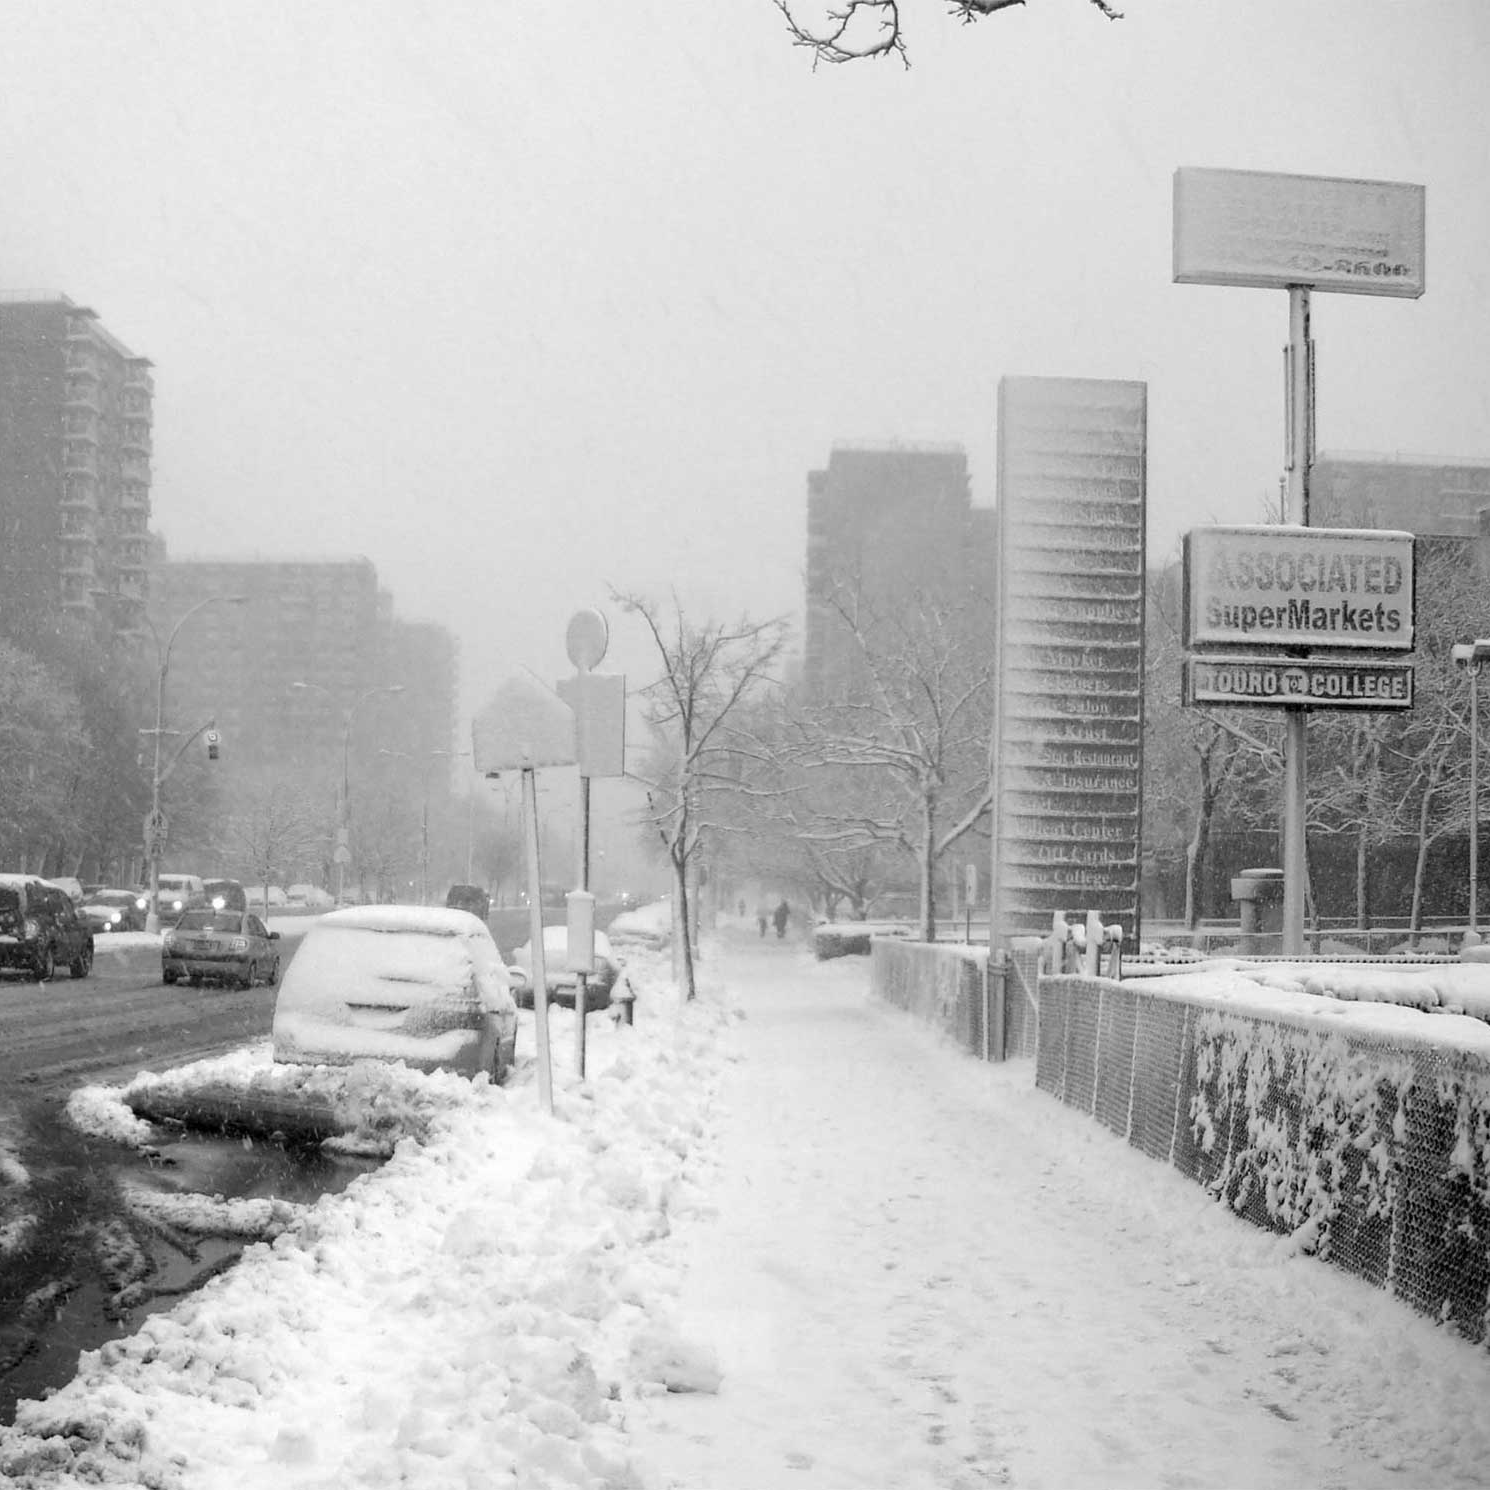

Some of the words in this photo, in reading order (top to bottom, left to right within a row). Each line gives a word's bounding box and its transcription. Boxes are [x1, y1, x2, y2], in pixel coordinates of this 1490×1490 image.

[1212, 551, 1402, 594] ASSOCIATED
[1207, 598, 1401, 632] SuperMarkets
[1207, 671, 1277, 694] TOURO
[1310, 675, 1405, 698] COLLEGE
[1066, 700, 1110, 713] Salon
[1065, 726, 1107, 740] Krust
[1073, 751, 1134, 768] Restaurant
[1063, 774, 1134, 788] Insurance
[1072, 822, 1123, 838] Center
[1072, 846, 1116, 861] Cards
[1053, 870, 1110, 887] College
